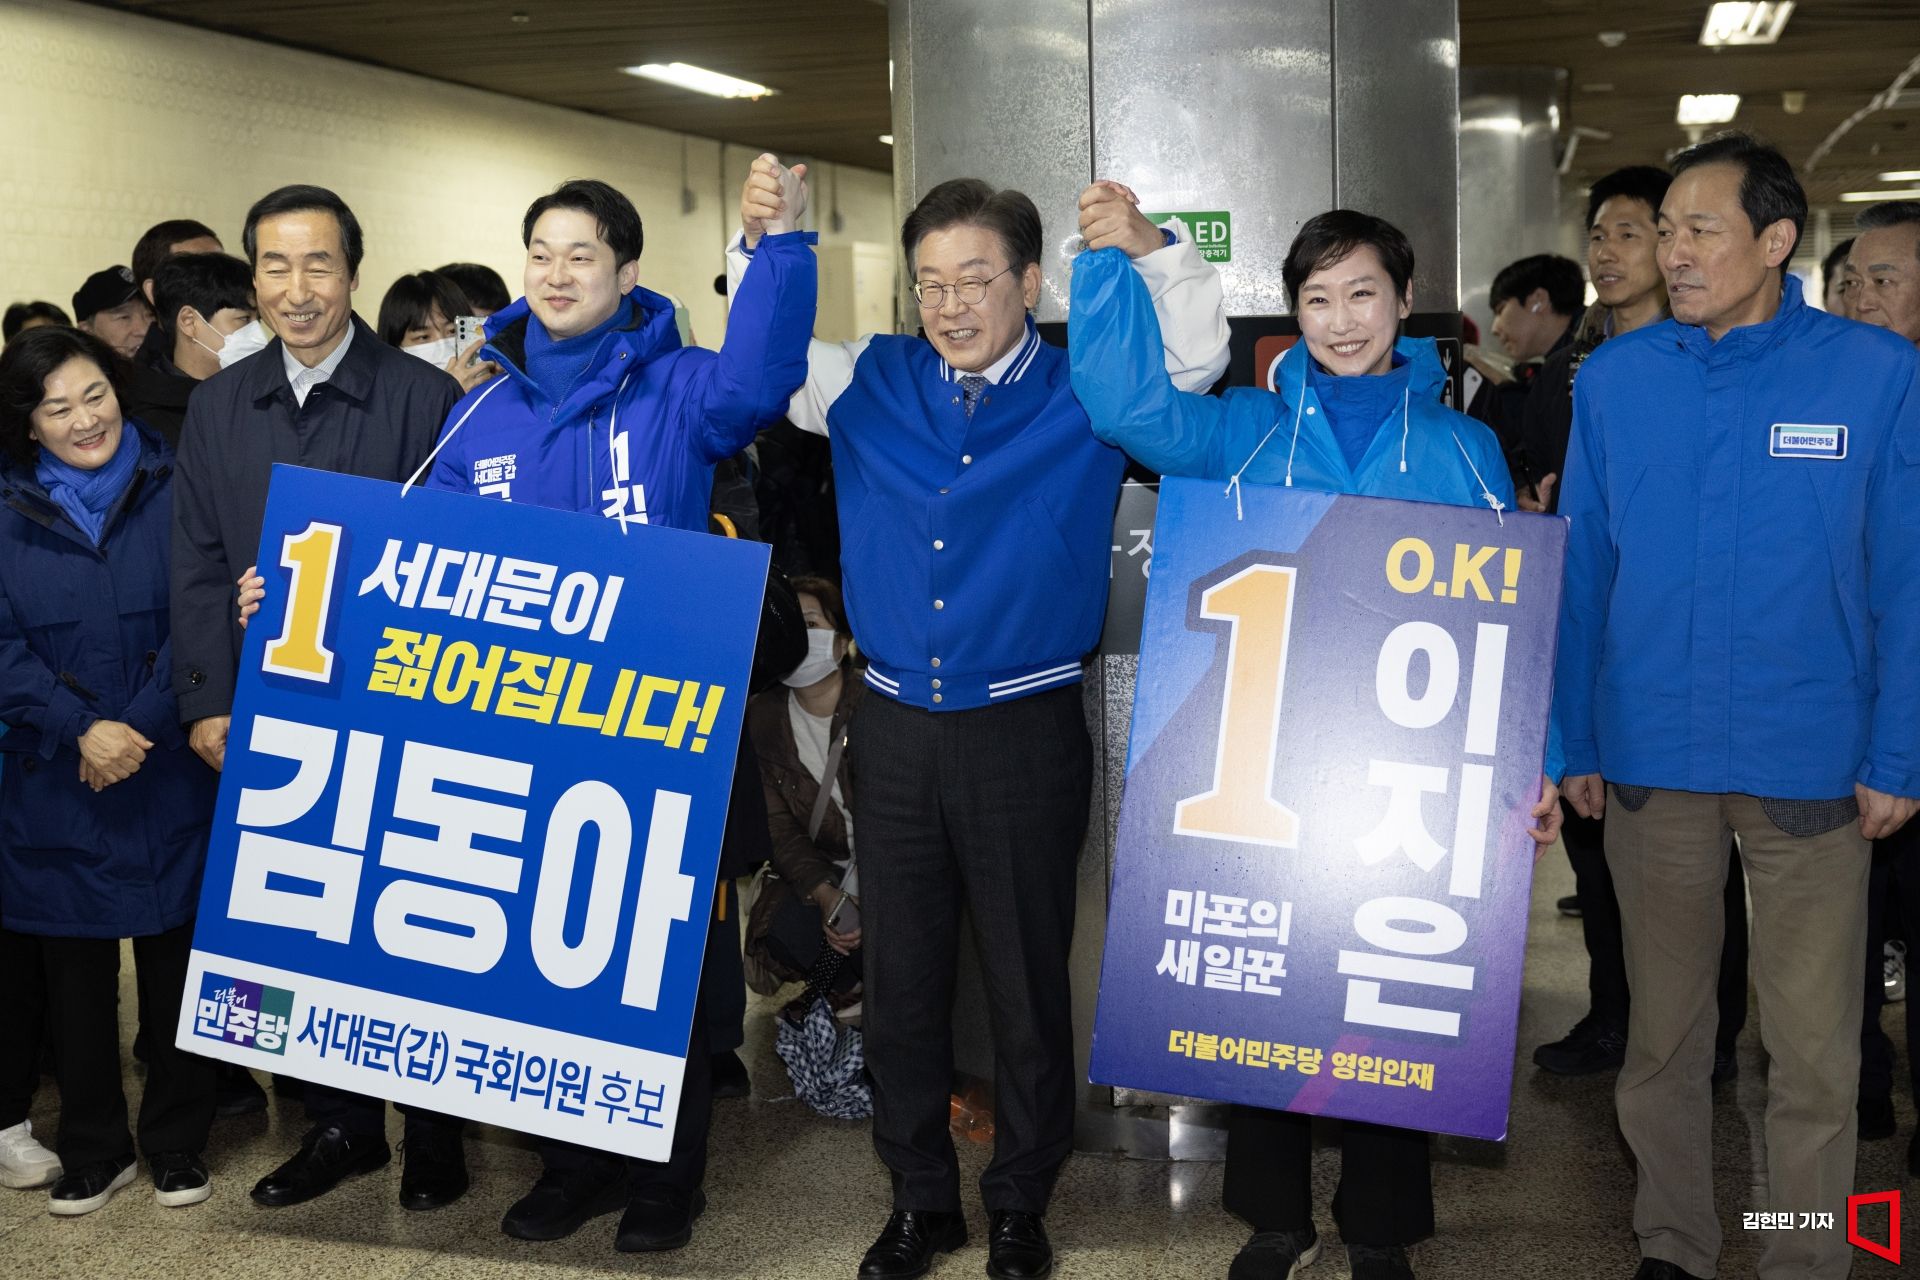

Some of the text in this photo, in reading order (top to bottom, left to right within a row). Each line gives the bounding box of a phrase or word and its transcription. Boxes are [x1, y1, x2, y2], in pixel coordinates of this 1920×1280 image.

[1183, 221, 1227, 243] ED
[1783, 436, 1834, 446] 더불어민주당
[474, 465, 517, 485] 서대문 갑
[262, 521, 343, 682] 1
[358, 538, 624, 642] 서대문이
[1385, 537, 1523, 604] O.K!
[366, 626, 725, 754] 젊어집니다!
[1172, 563, 1298, 849] 1
[1337, 621, 1510, 1037] 이지은
[226, 714, 695, 1011] 김동아
[1164, 889, 1293, 946] 마포의
[213, 986, 248, 1008] 더불어
[1155, 939, 1287, 996] 새일꾼
[197, 998, 289, 1050] 민주당
[296, 1005, 666, 1129] 서대문(갑) 국회의원 후보
[1168, 1029, 1435, 1091] 더불어민주당 영입인재
